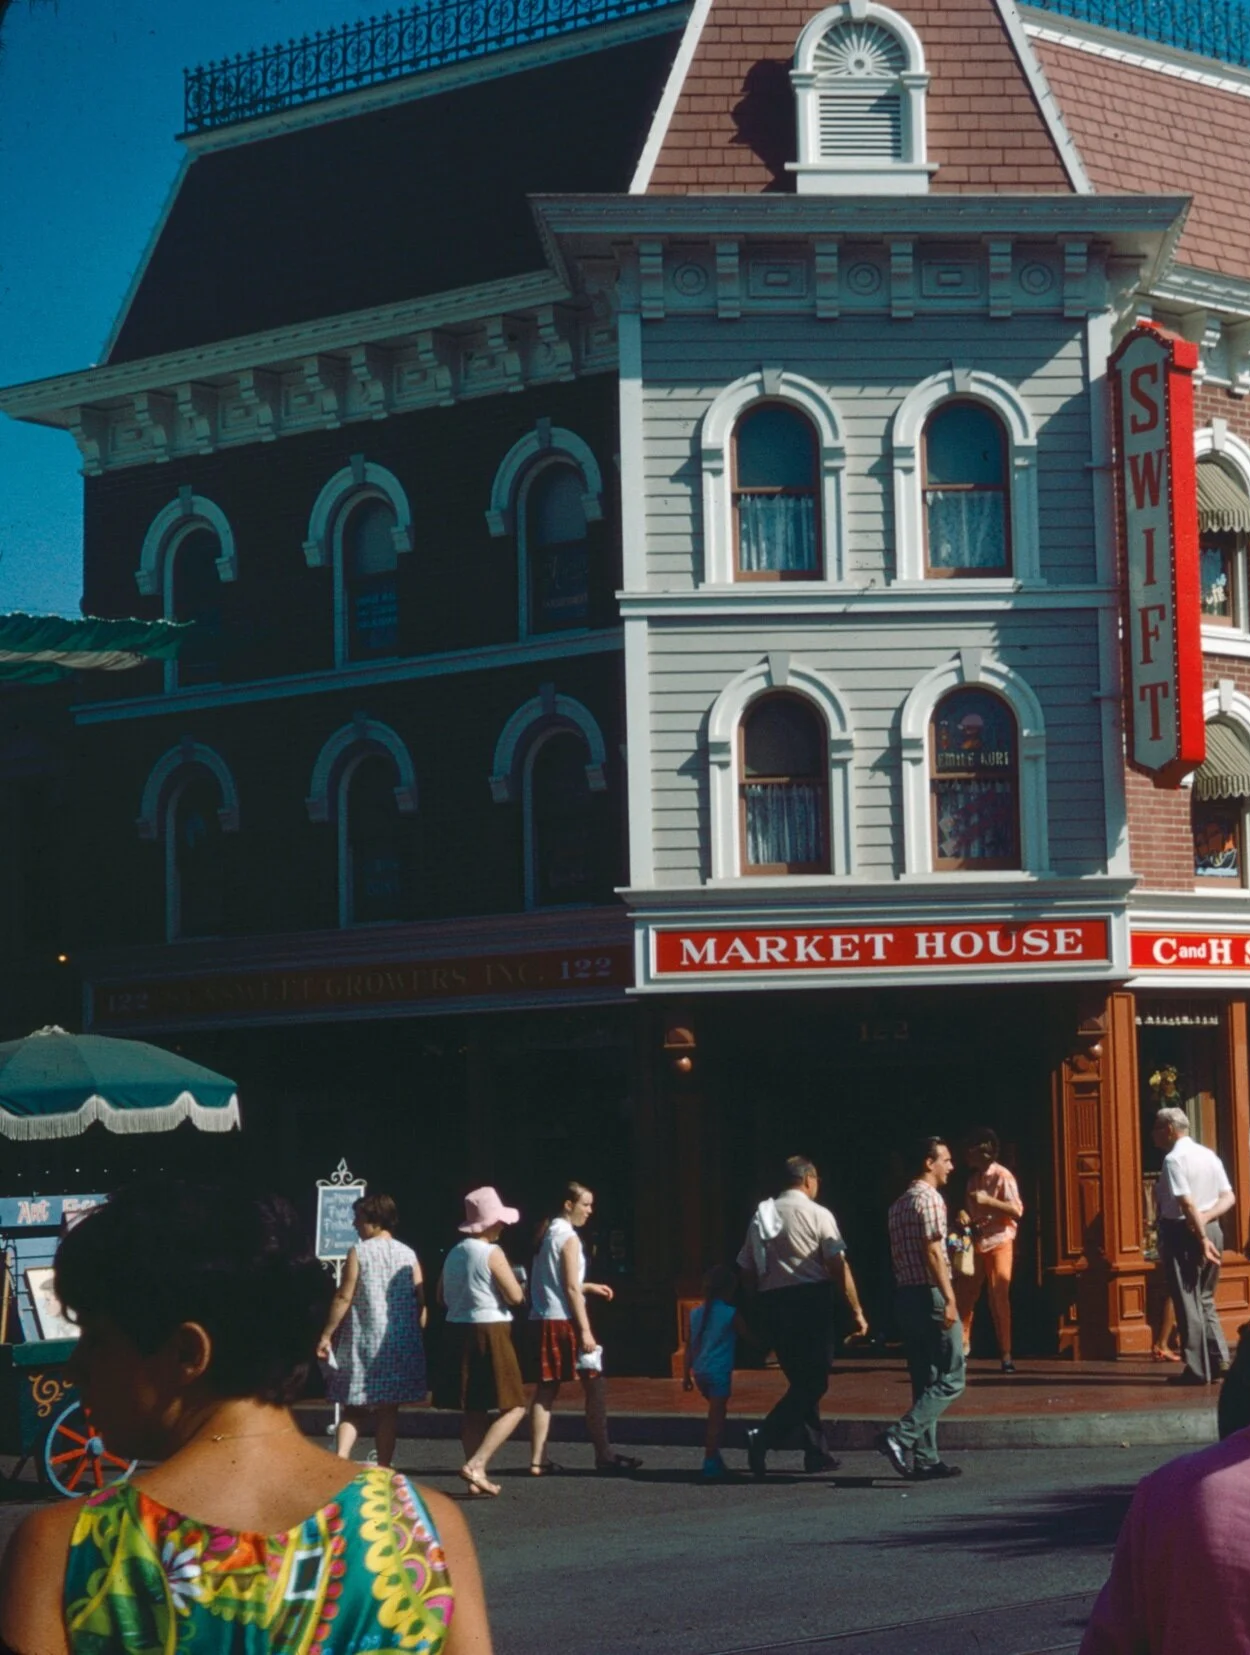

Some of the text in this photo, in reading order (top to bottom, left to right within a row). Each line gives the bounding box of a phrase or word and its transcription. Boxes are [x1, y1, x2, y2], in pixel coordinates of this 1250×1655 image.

[1127, 362, 1169, 741] SWIFT
[679, 928, 1083, 965] MARKET HOUSE
[325, 967, 468, 998] GROWERS
[484, 961, 544, 986] INC.
[559, 956, 612, 980] 122
